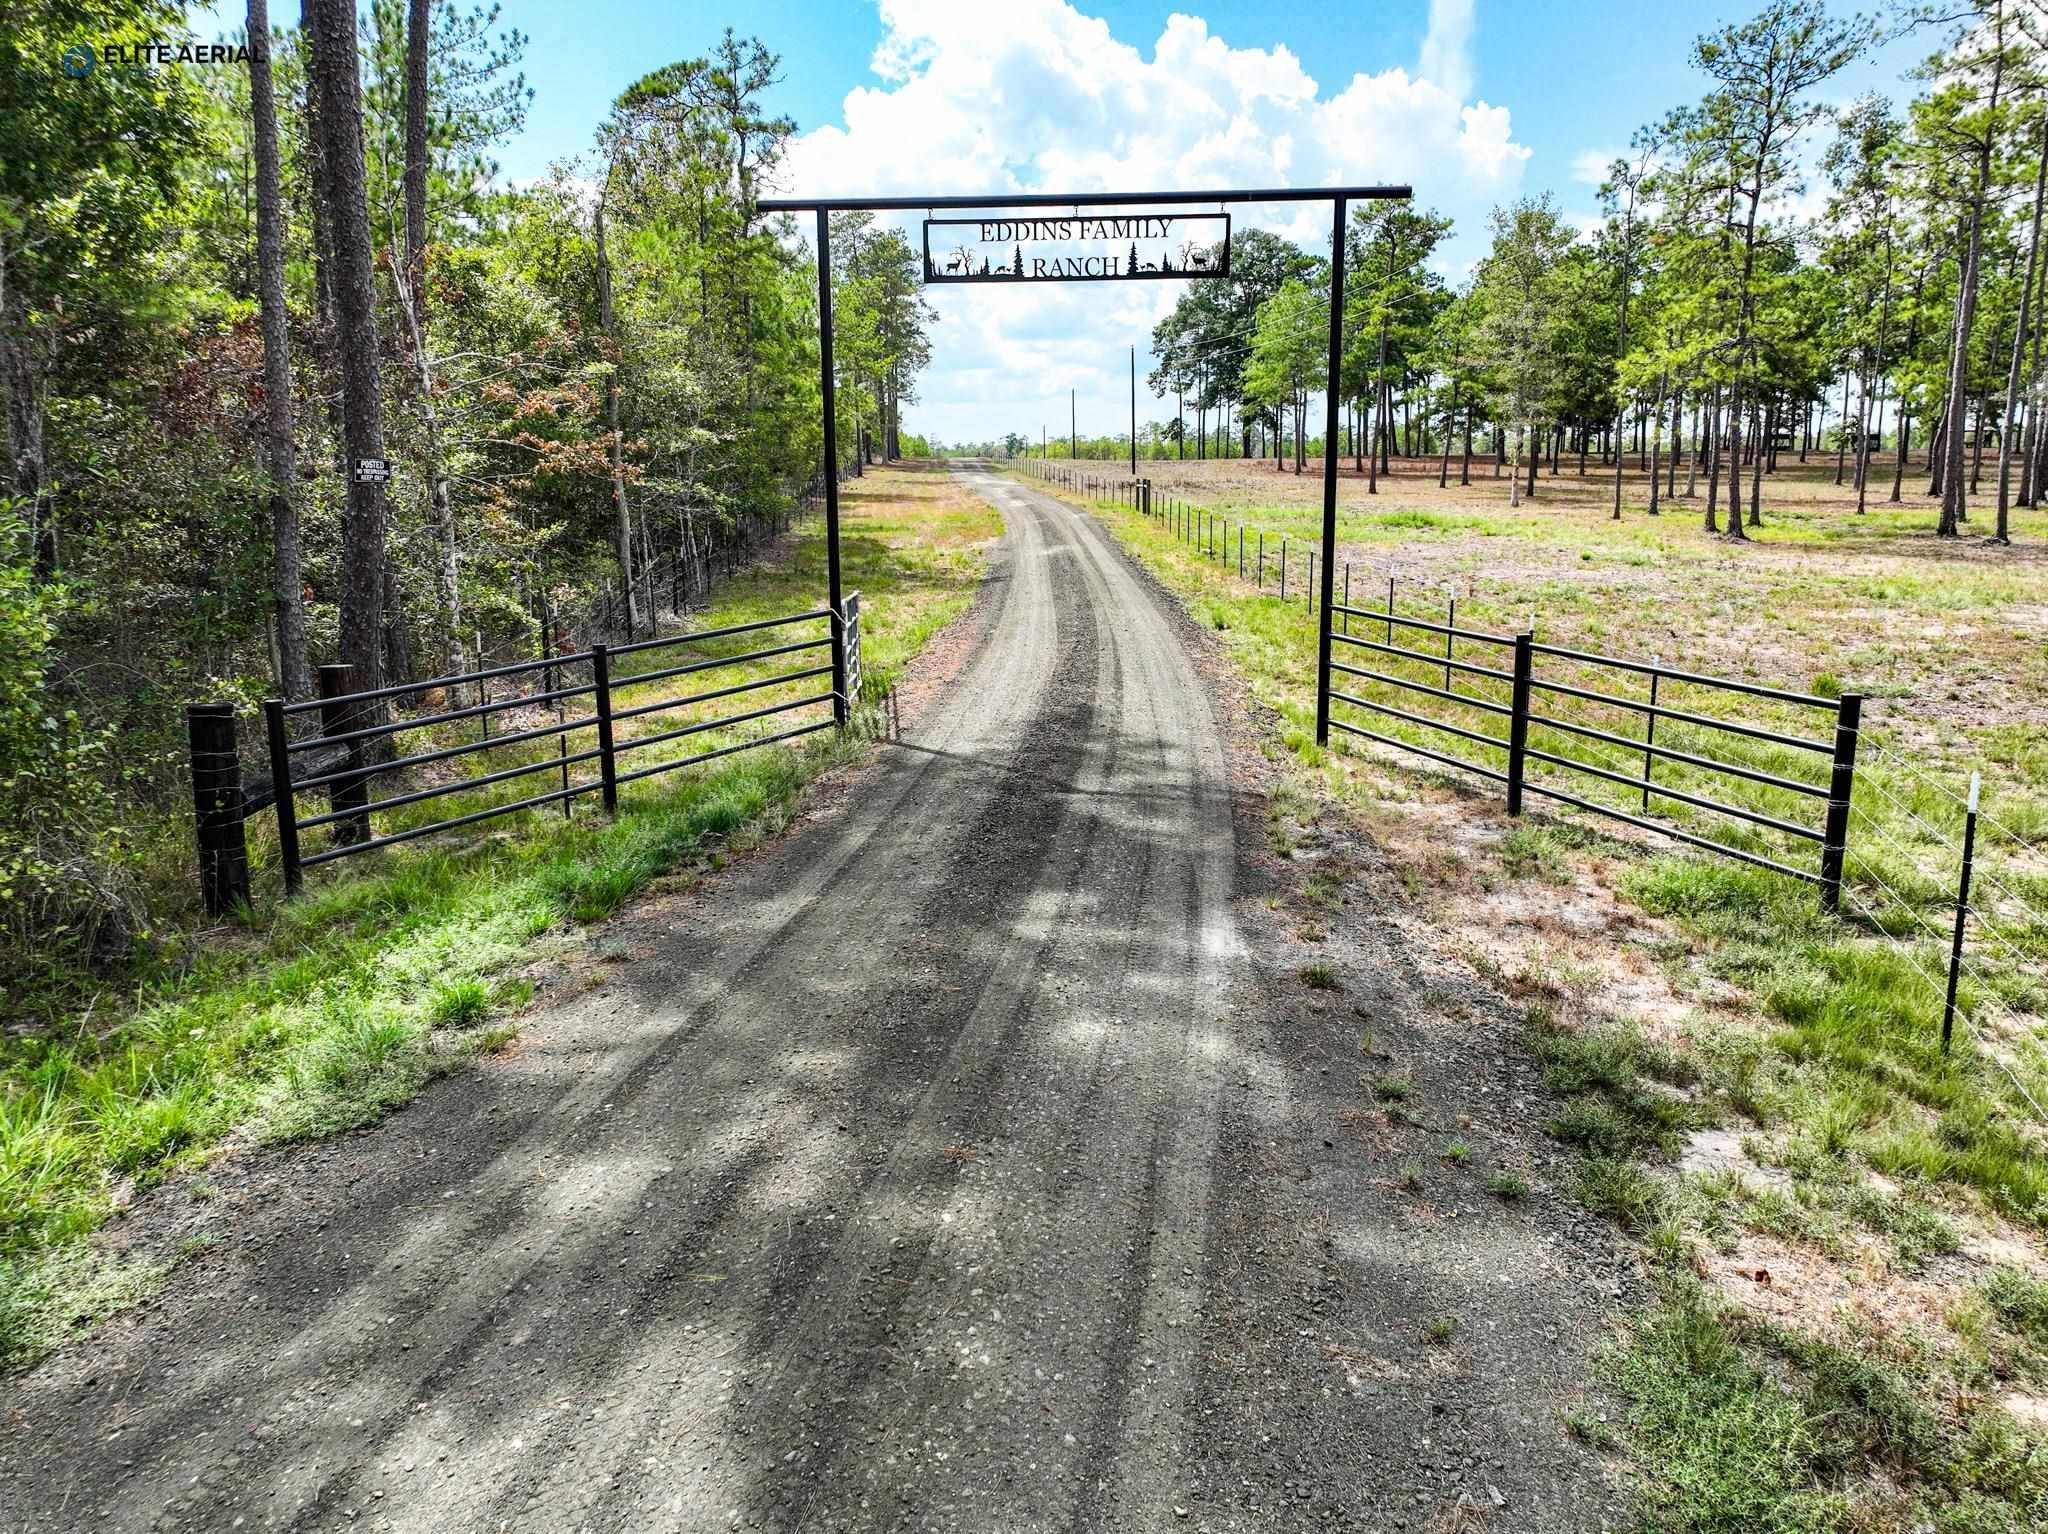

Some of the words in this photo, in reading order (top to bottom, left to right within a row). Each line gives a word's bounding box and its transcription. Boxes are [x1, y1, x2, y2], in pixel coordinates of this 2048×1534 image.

[980, 221, 1072, 242] EDDINS
[1079, 219, 1174, 240] FAMILY
[1032, 257, 1120, 278] RANCH
[361, 460, 384, 469] POSTED
